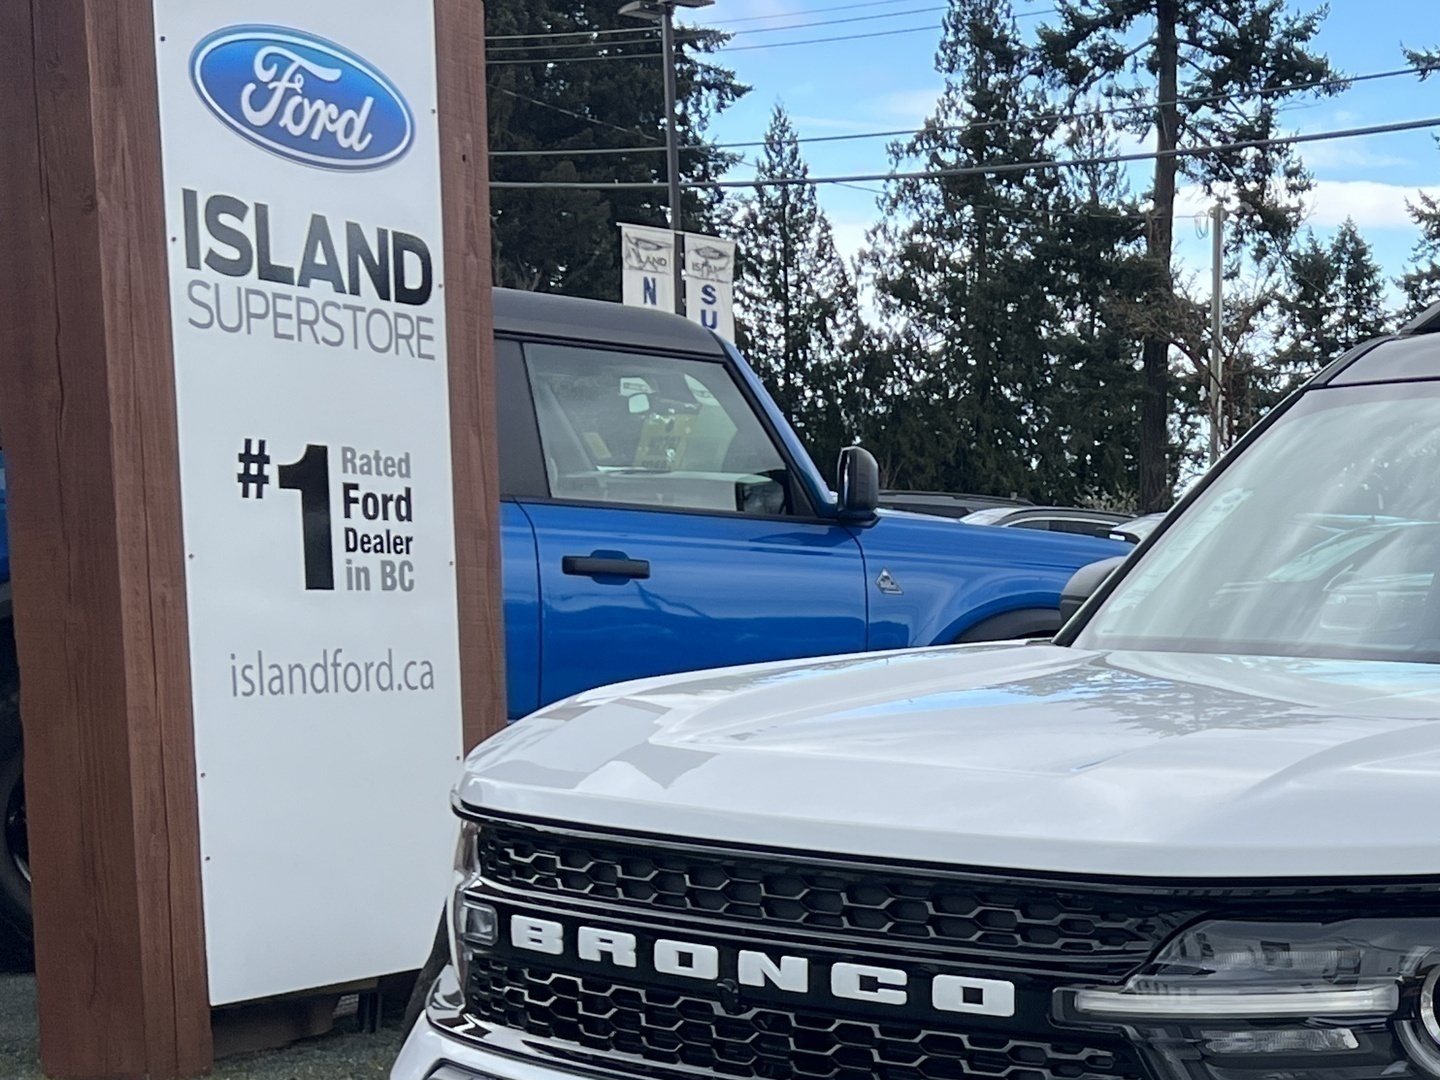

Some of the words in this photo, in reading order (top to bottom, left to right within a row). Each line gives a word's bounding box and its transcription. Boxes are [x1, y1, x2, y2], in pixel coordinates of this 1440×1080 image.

[241, 46, 374, 152] Ford
[181, 187, 433, 306] ISLAND
[187, 279, 436, 361] SUPERSTORE
[341, 446, 411, 478] Rated
[236, 438, 335, 591] #1
[342, 482, 413, 523] Ford
[344, 527, 414, 555] Dealer
[346, 558, 371, 591] in
[380, 559, 415, 592] BC
[230, 648, 435, 697] islandford.ca
[510, 914, 1015, 1017] BRONCO
